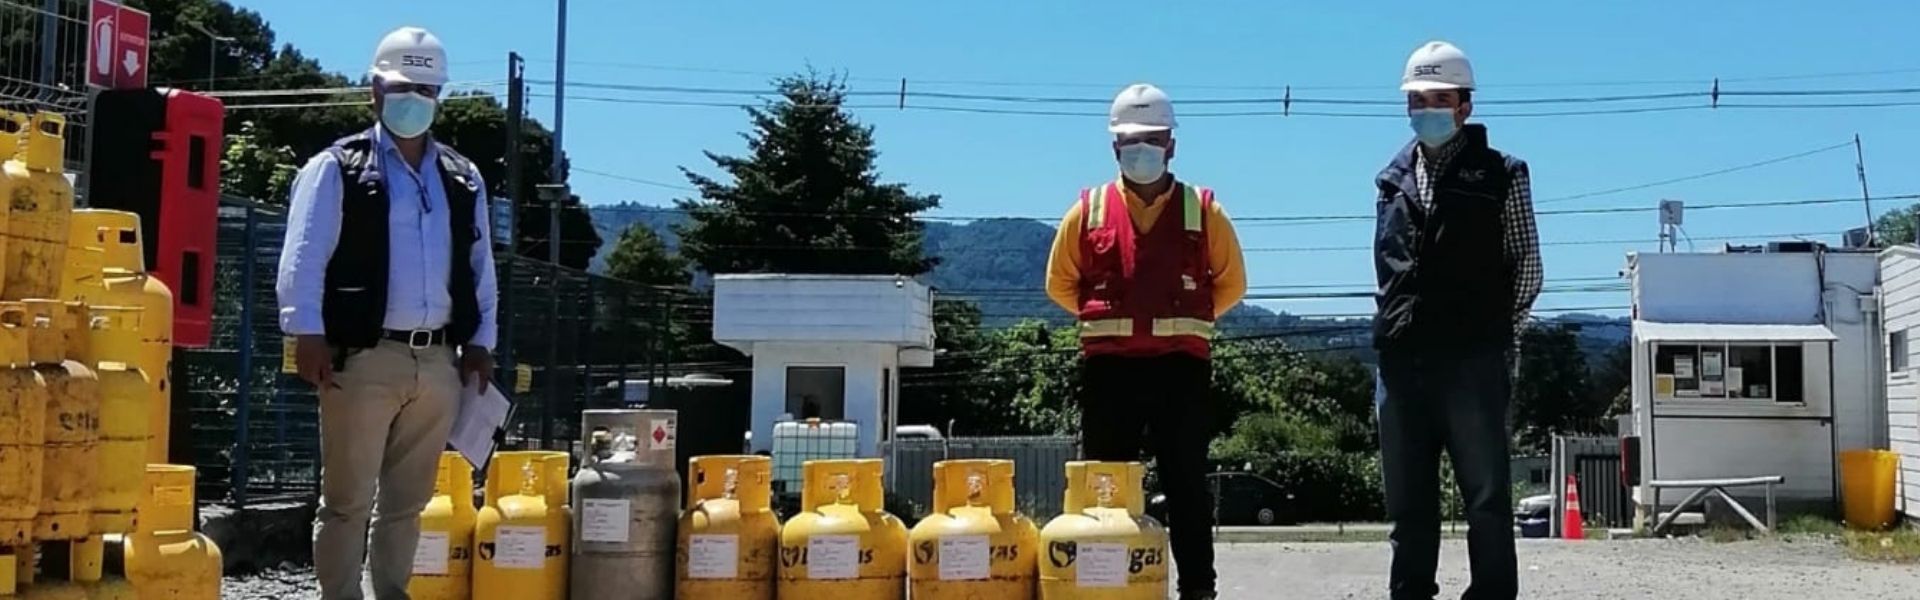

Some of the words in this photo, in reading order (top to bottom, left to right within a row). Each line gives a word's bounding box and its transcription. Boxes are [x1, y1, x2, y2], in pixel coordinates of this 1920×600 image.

[402, 55, 433, 68] SEC
[1414, 64, 1442, 76] SEC
[544, 544, 561, 558] as
[1127, 547, 1163, 574] gas
